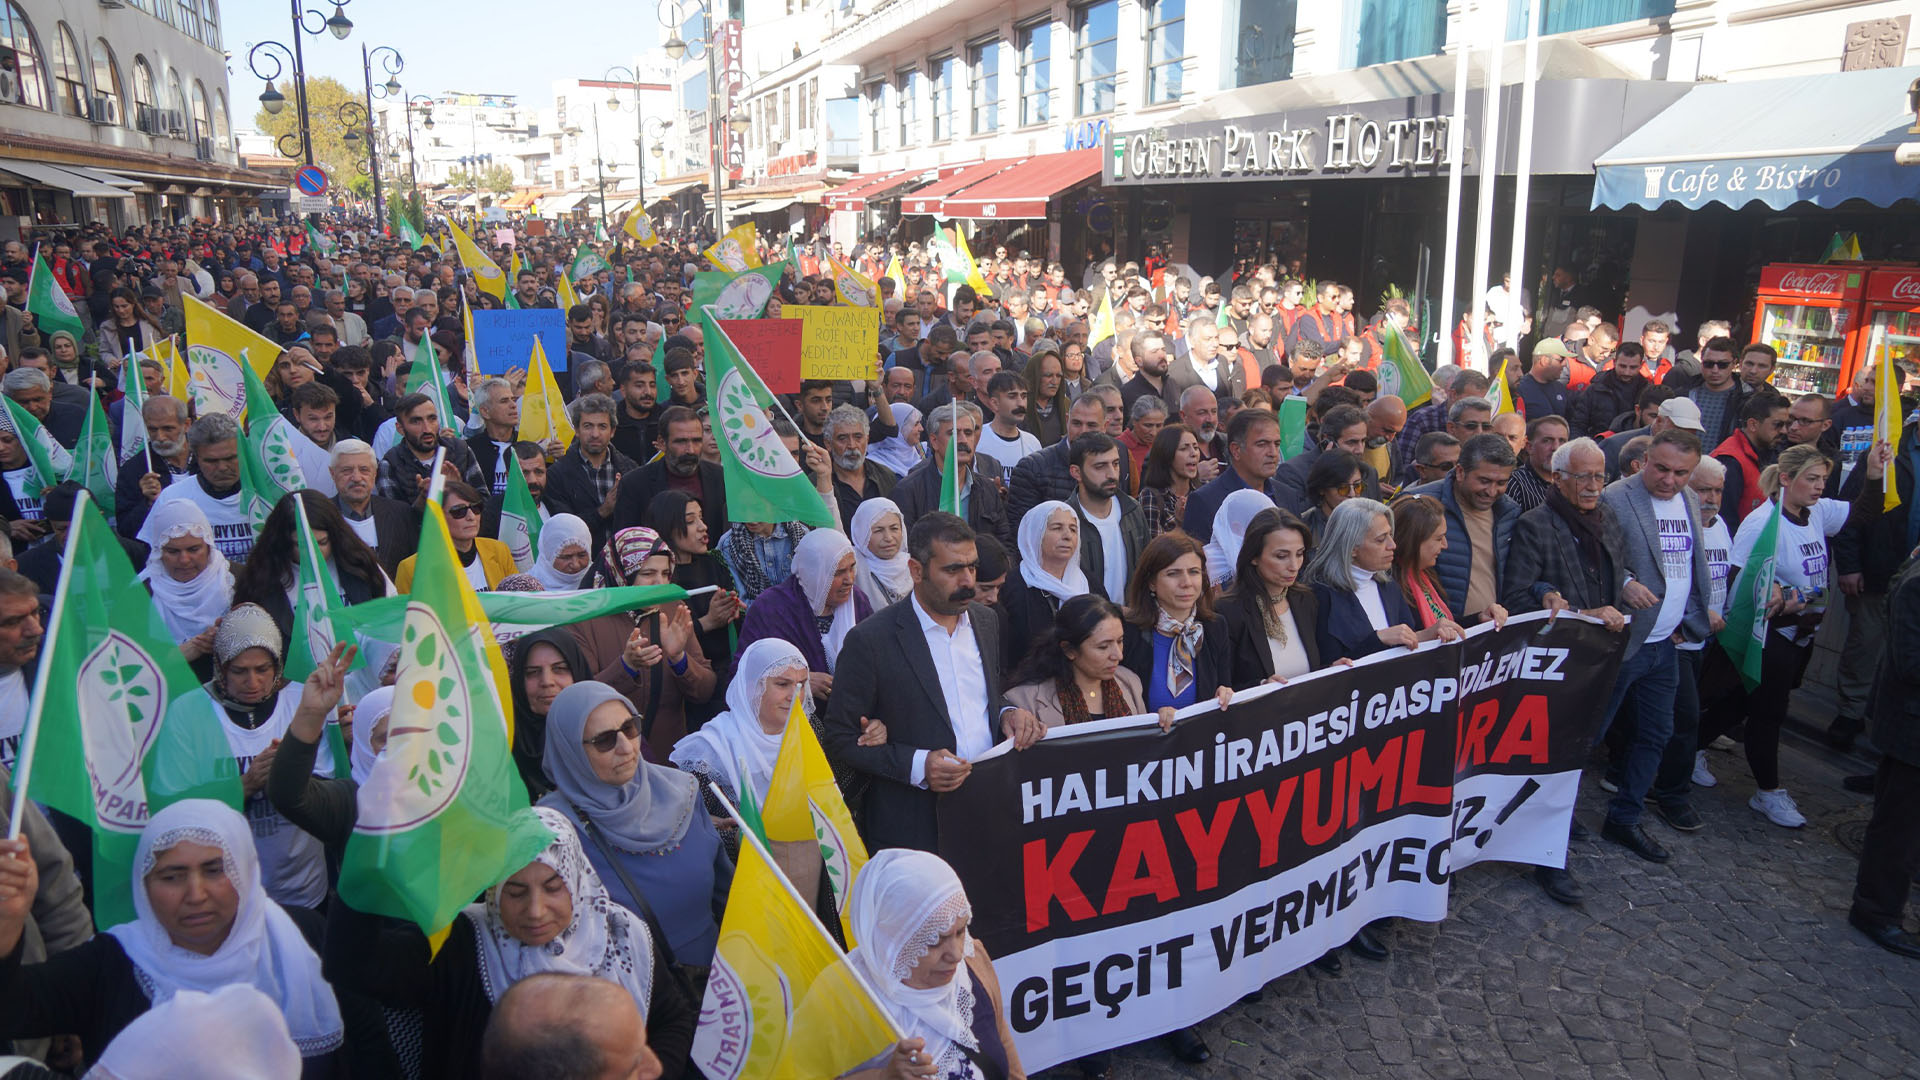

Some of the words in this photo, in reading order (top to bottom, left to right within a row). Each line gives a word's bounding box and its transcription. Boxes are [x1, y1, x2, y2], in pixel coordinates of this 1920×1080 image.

[1065, 119, 1110, 150] MADO
[1131, 133, 1212, 176] GREEN
[1222, 125, 1312, 172] PARK
[1667, 164, 1719, 200] Cafe
[1726, 166, 1748, 191] &
[1755, 163, 1841, 191] Bistro
[1021, 750, 1204, 825] HALKIN
[1214, 689, 1359, 784] İRADESİ
[1364, 677, 1458, 737] GASP
[1010, 933, 1194, 1033] GEÇİT
